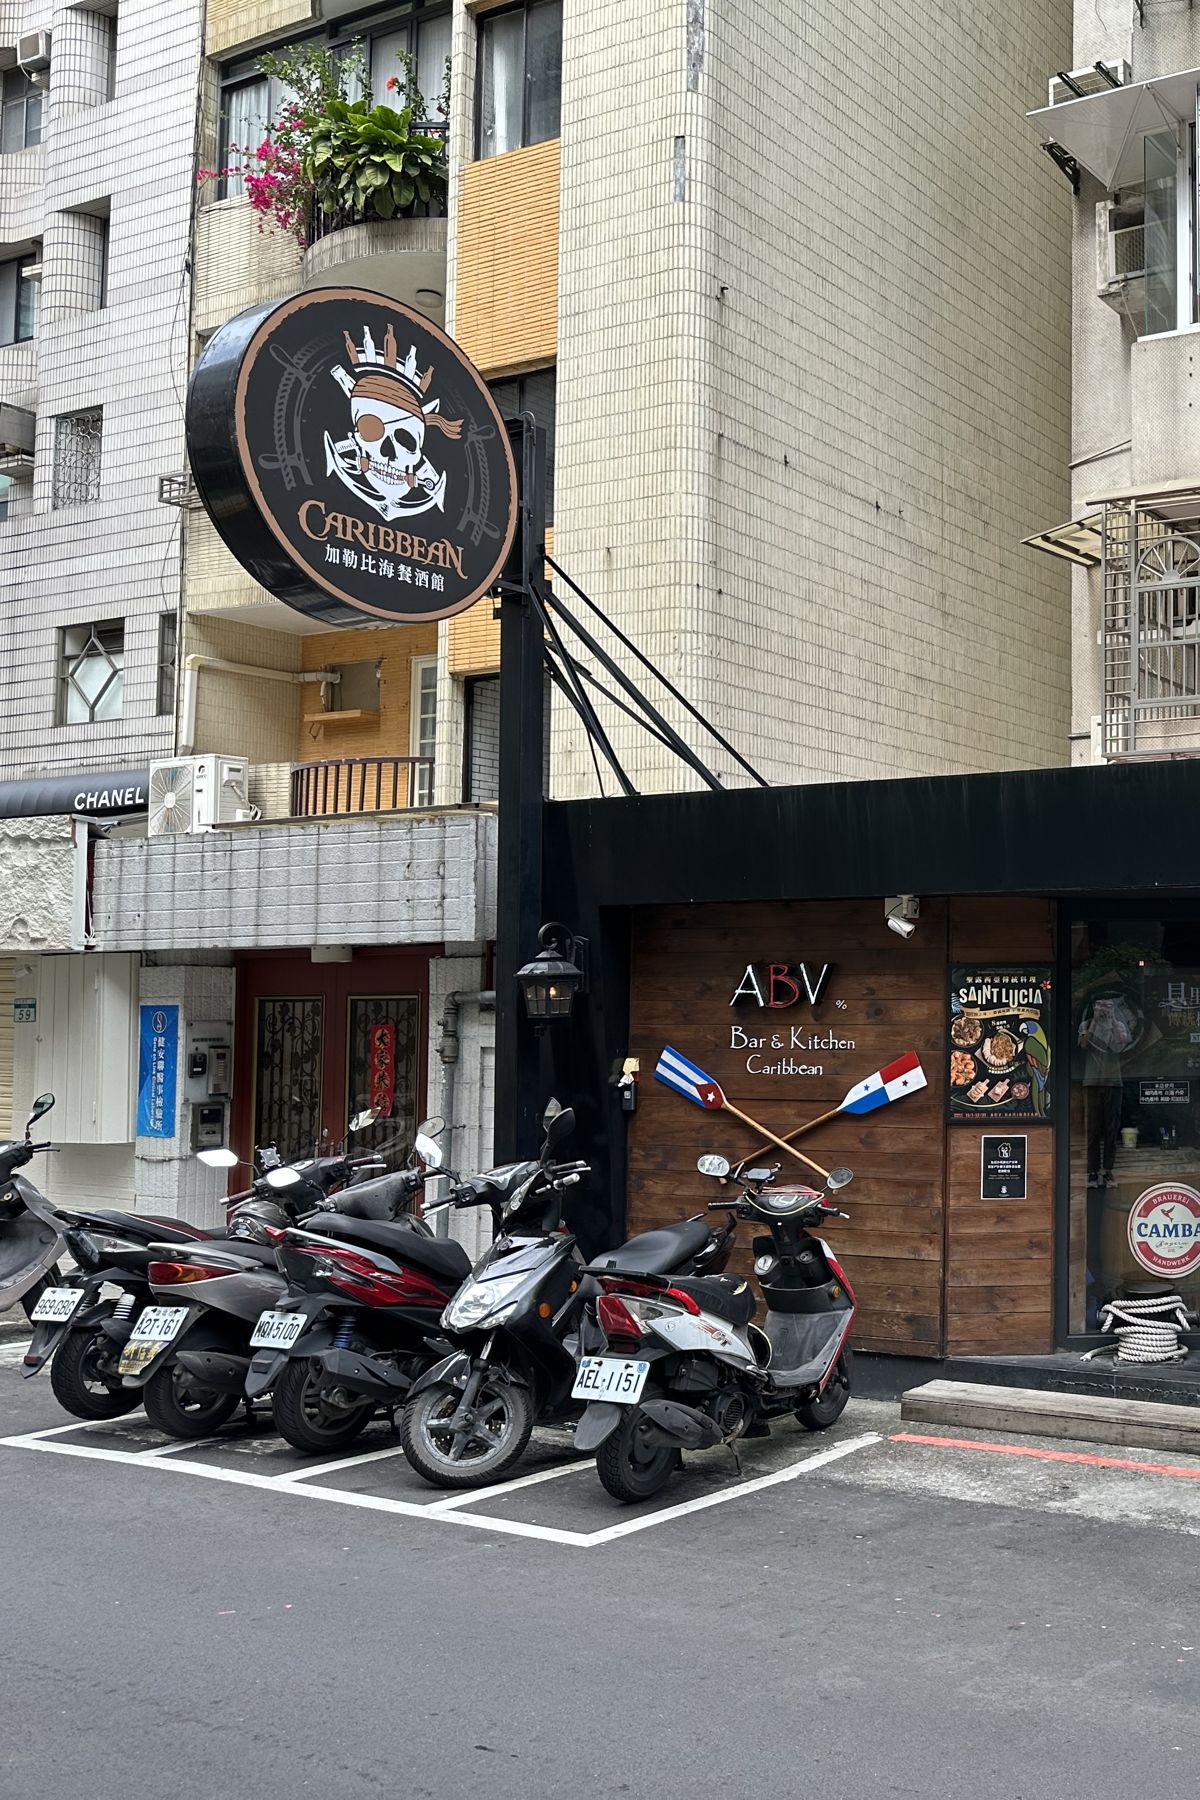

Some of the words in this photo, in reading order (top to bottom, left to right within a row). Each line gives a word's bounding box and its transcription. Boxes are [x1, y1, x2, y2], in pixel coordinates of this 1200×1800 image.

[297, 500, 468, 579] CARIBBEAN
[325, 543, 445, 592] 加勒比海餐酒館
[74, 787, 144, 810] CHANEL
[729, 962, 829, 1009] ABV
[959, 984, 1000, 1005] SAINT
[1001, 987, 1043, 1008] LUCIA
[18, 1009, 31, 1021] 59
[730, 1025, 767, 1049] Bar
[771, 1034, 784, 1048] &
[790, 1026, 855, 1050] Kitchen
[746, 1054, 823, 1075] Caribbean
[1152, 1194, 1190, 1205] BRAUEREI
[1152, 1255, 1191, 1267] HANDWERK
[576, 1369, 641, 1393] AEL-1151
